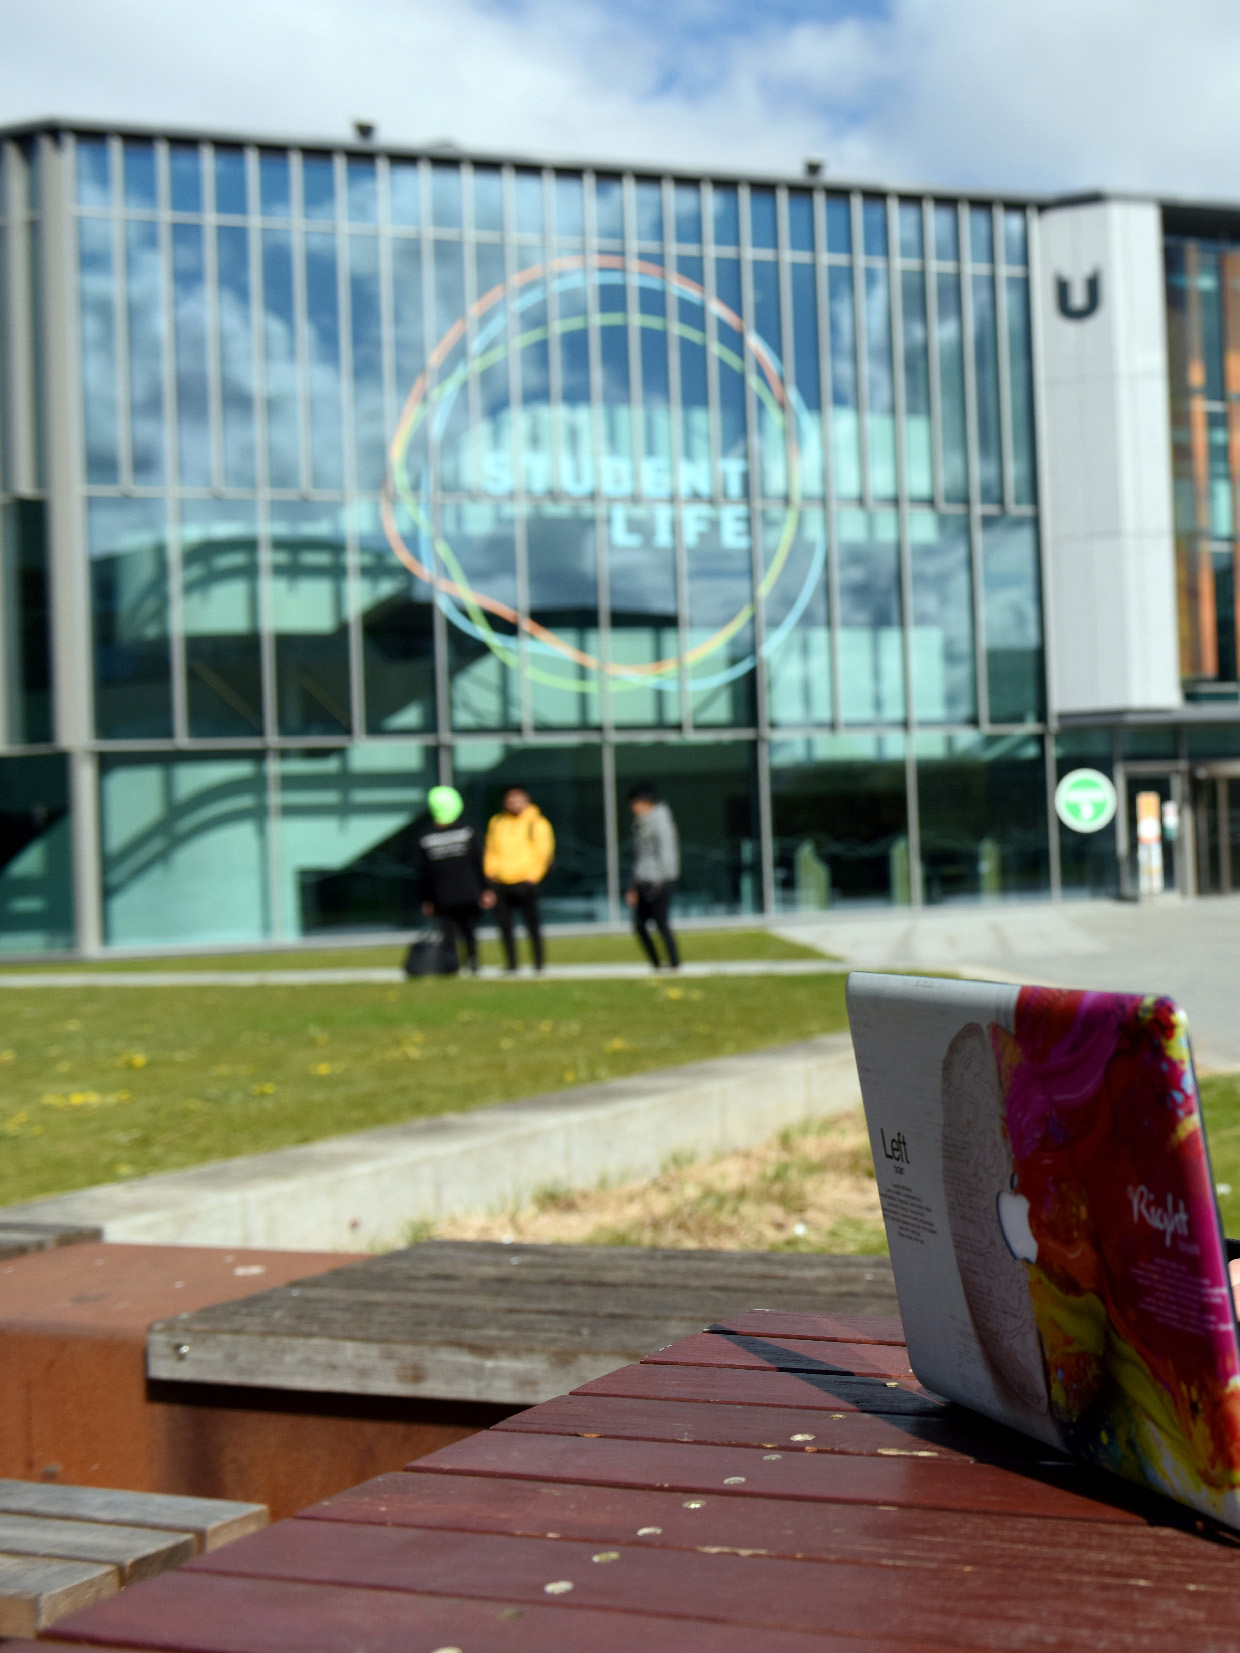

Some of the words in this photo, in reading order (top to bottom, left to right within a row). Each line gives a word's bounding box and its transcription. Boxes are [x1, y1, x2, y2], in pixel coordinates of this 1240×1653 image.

[481, 452, 748, 497] STUDENT
[610, 503, 750, 549] LIFE
[880, 1127, 910, 1164] Left
[1127, 1184, 1189, 1248] Right
